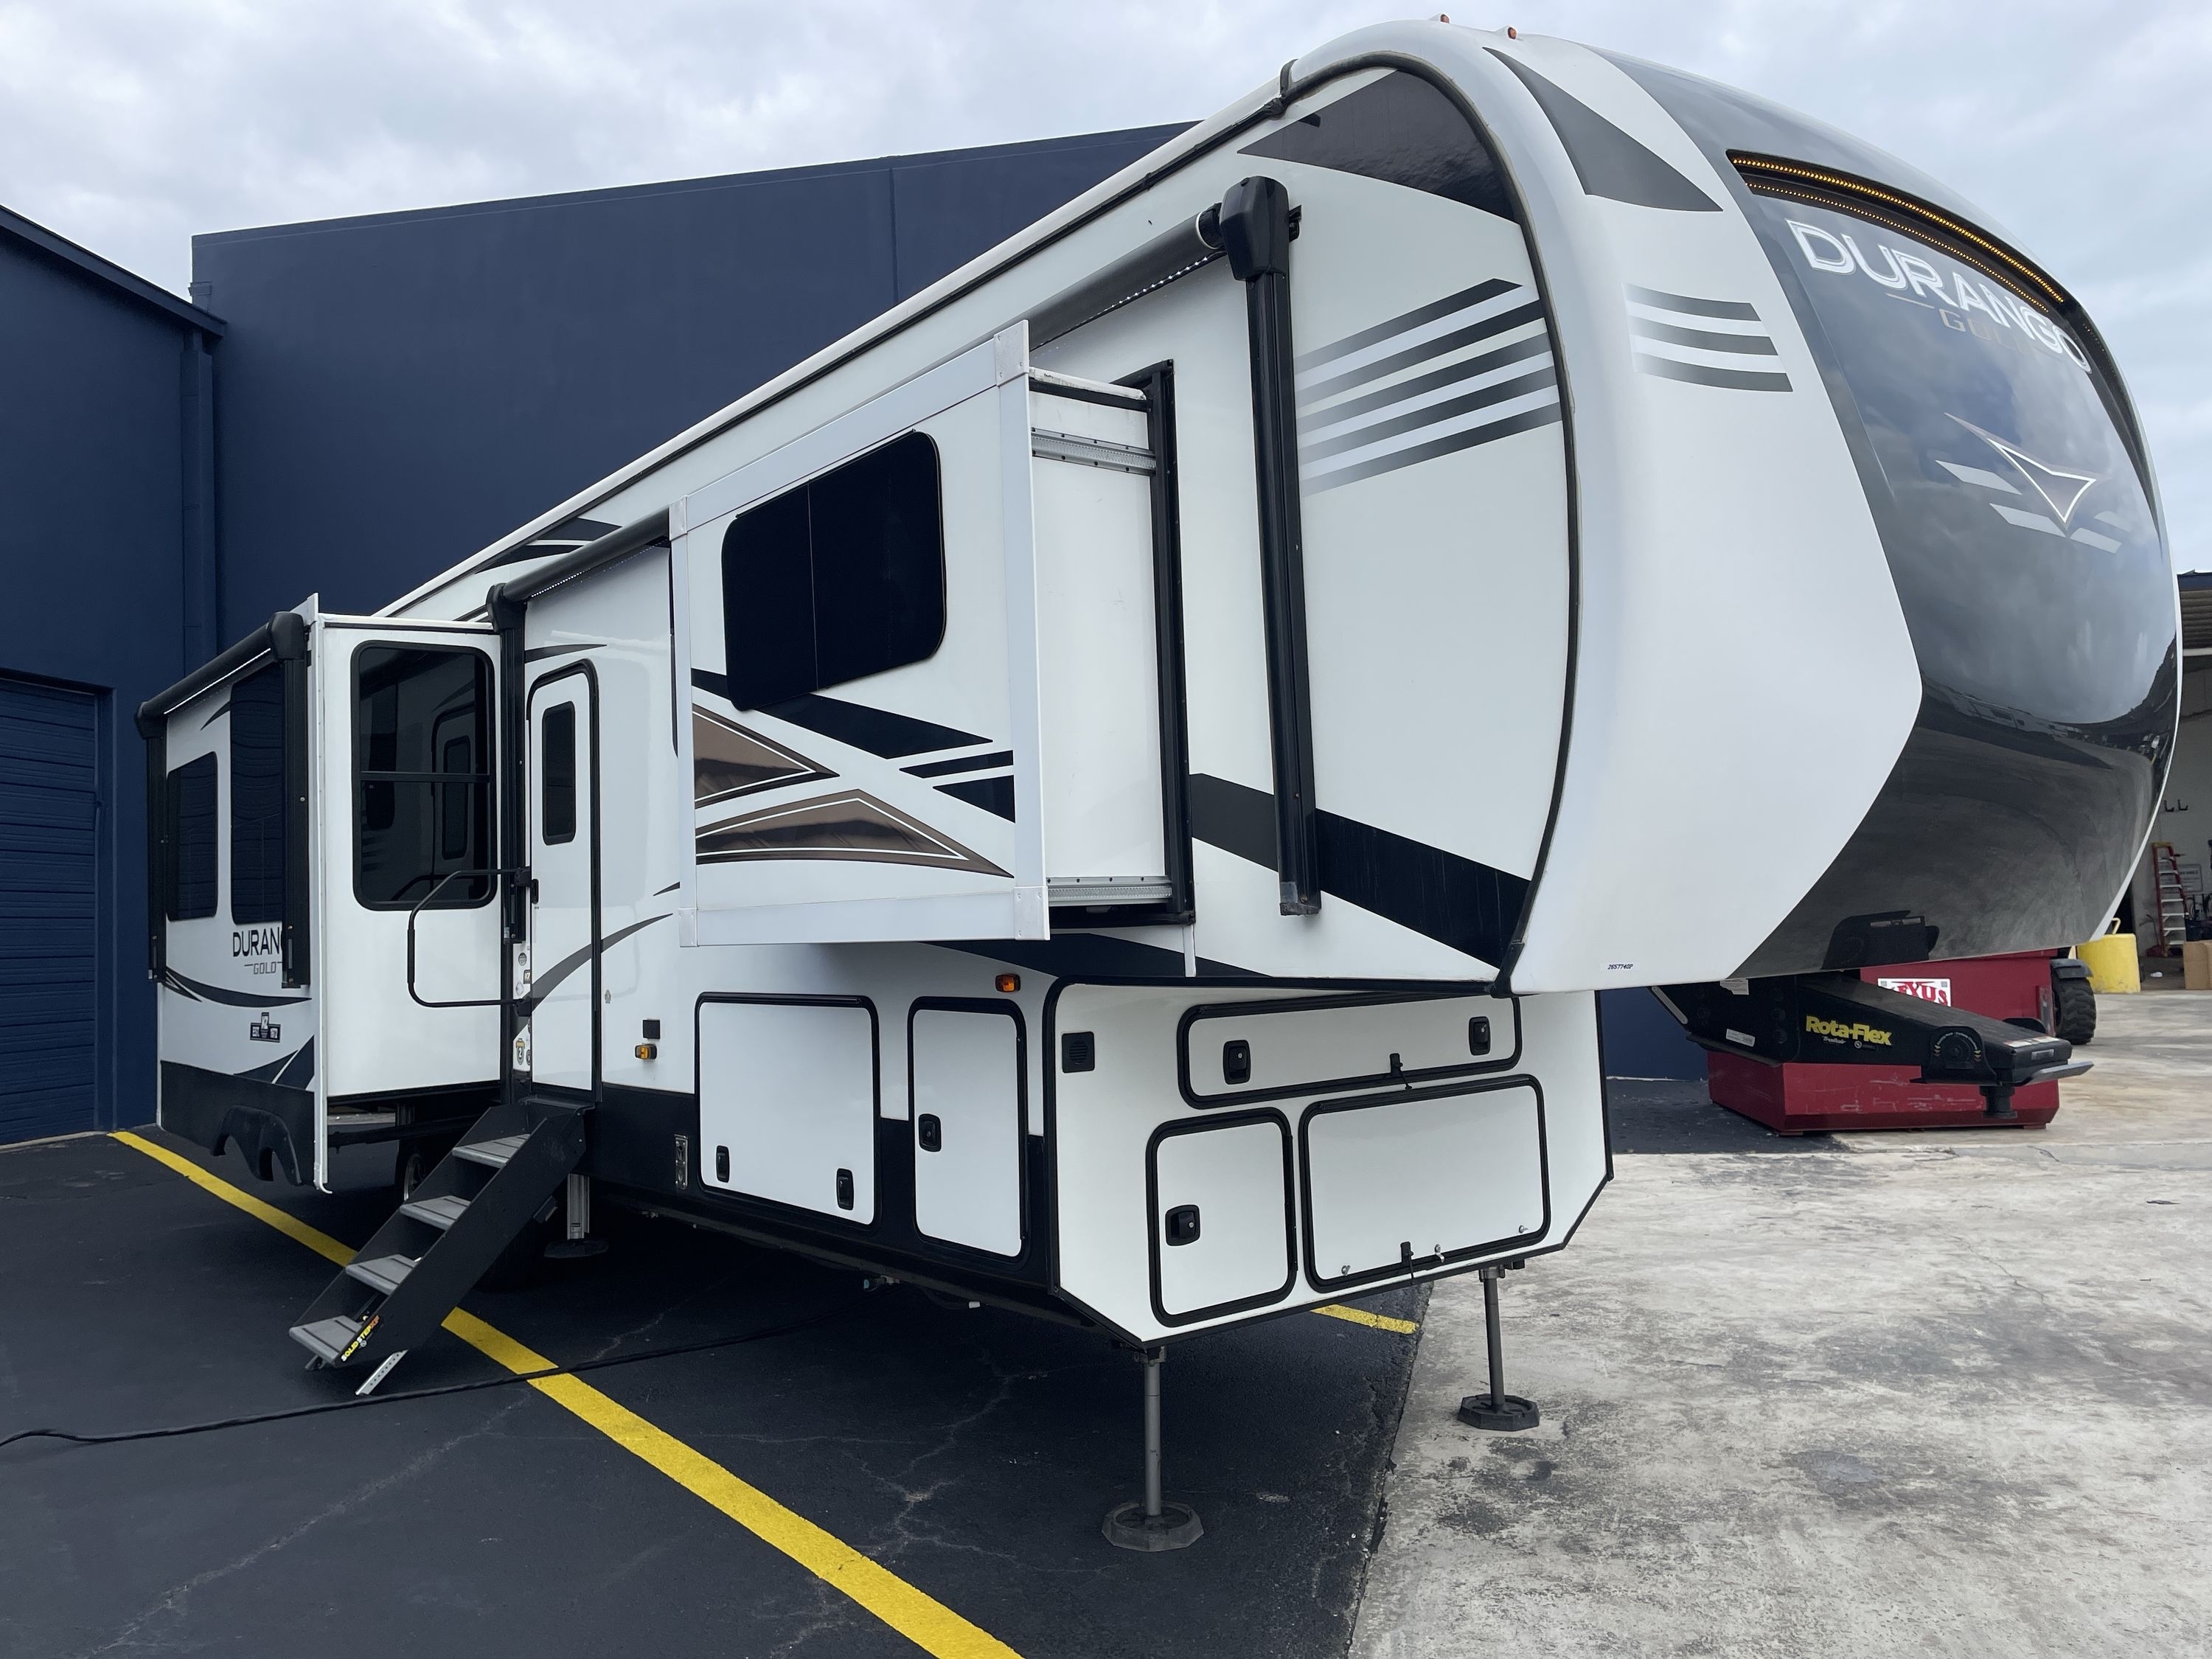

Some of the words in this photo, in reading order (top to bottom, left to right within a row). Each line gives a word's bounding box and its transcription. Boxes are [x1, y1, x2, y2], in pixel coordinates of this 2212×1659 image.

[1784, 218, 2093, 374] DURANGO
[233, 926, 282, 957] DURAN
[254, 961, 276, 975] GOLD
